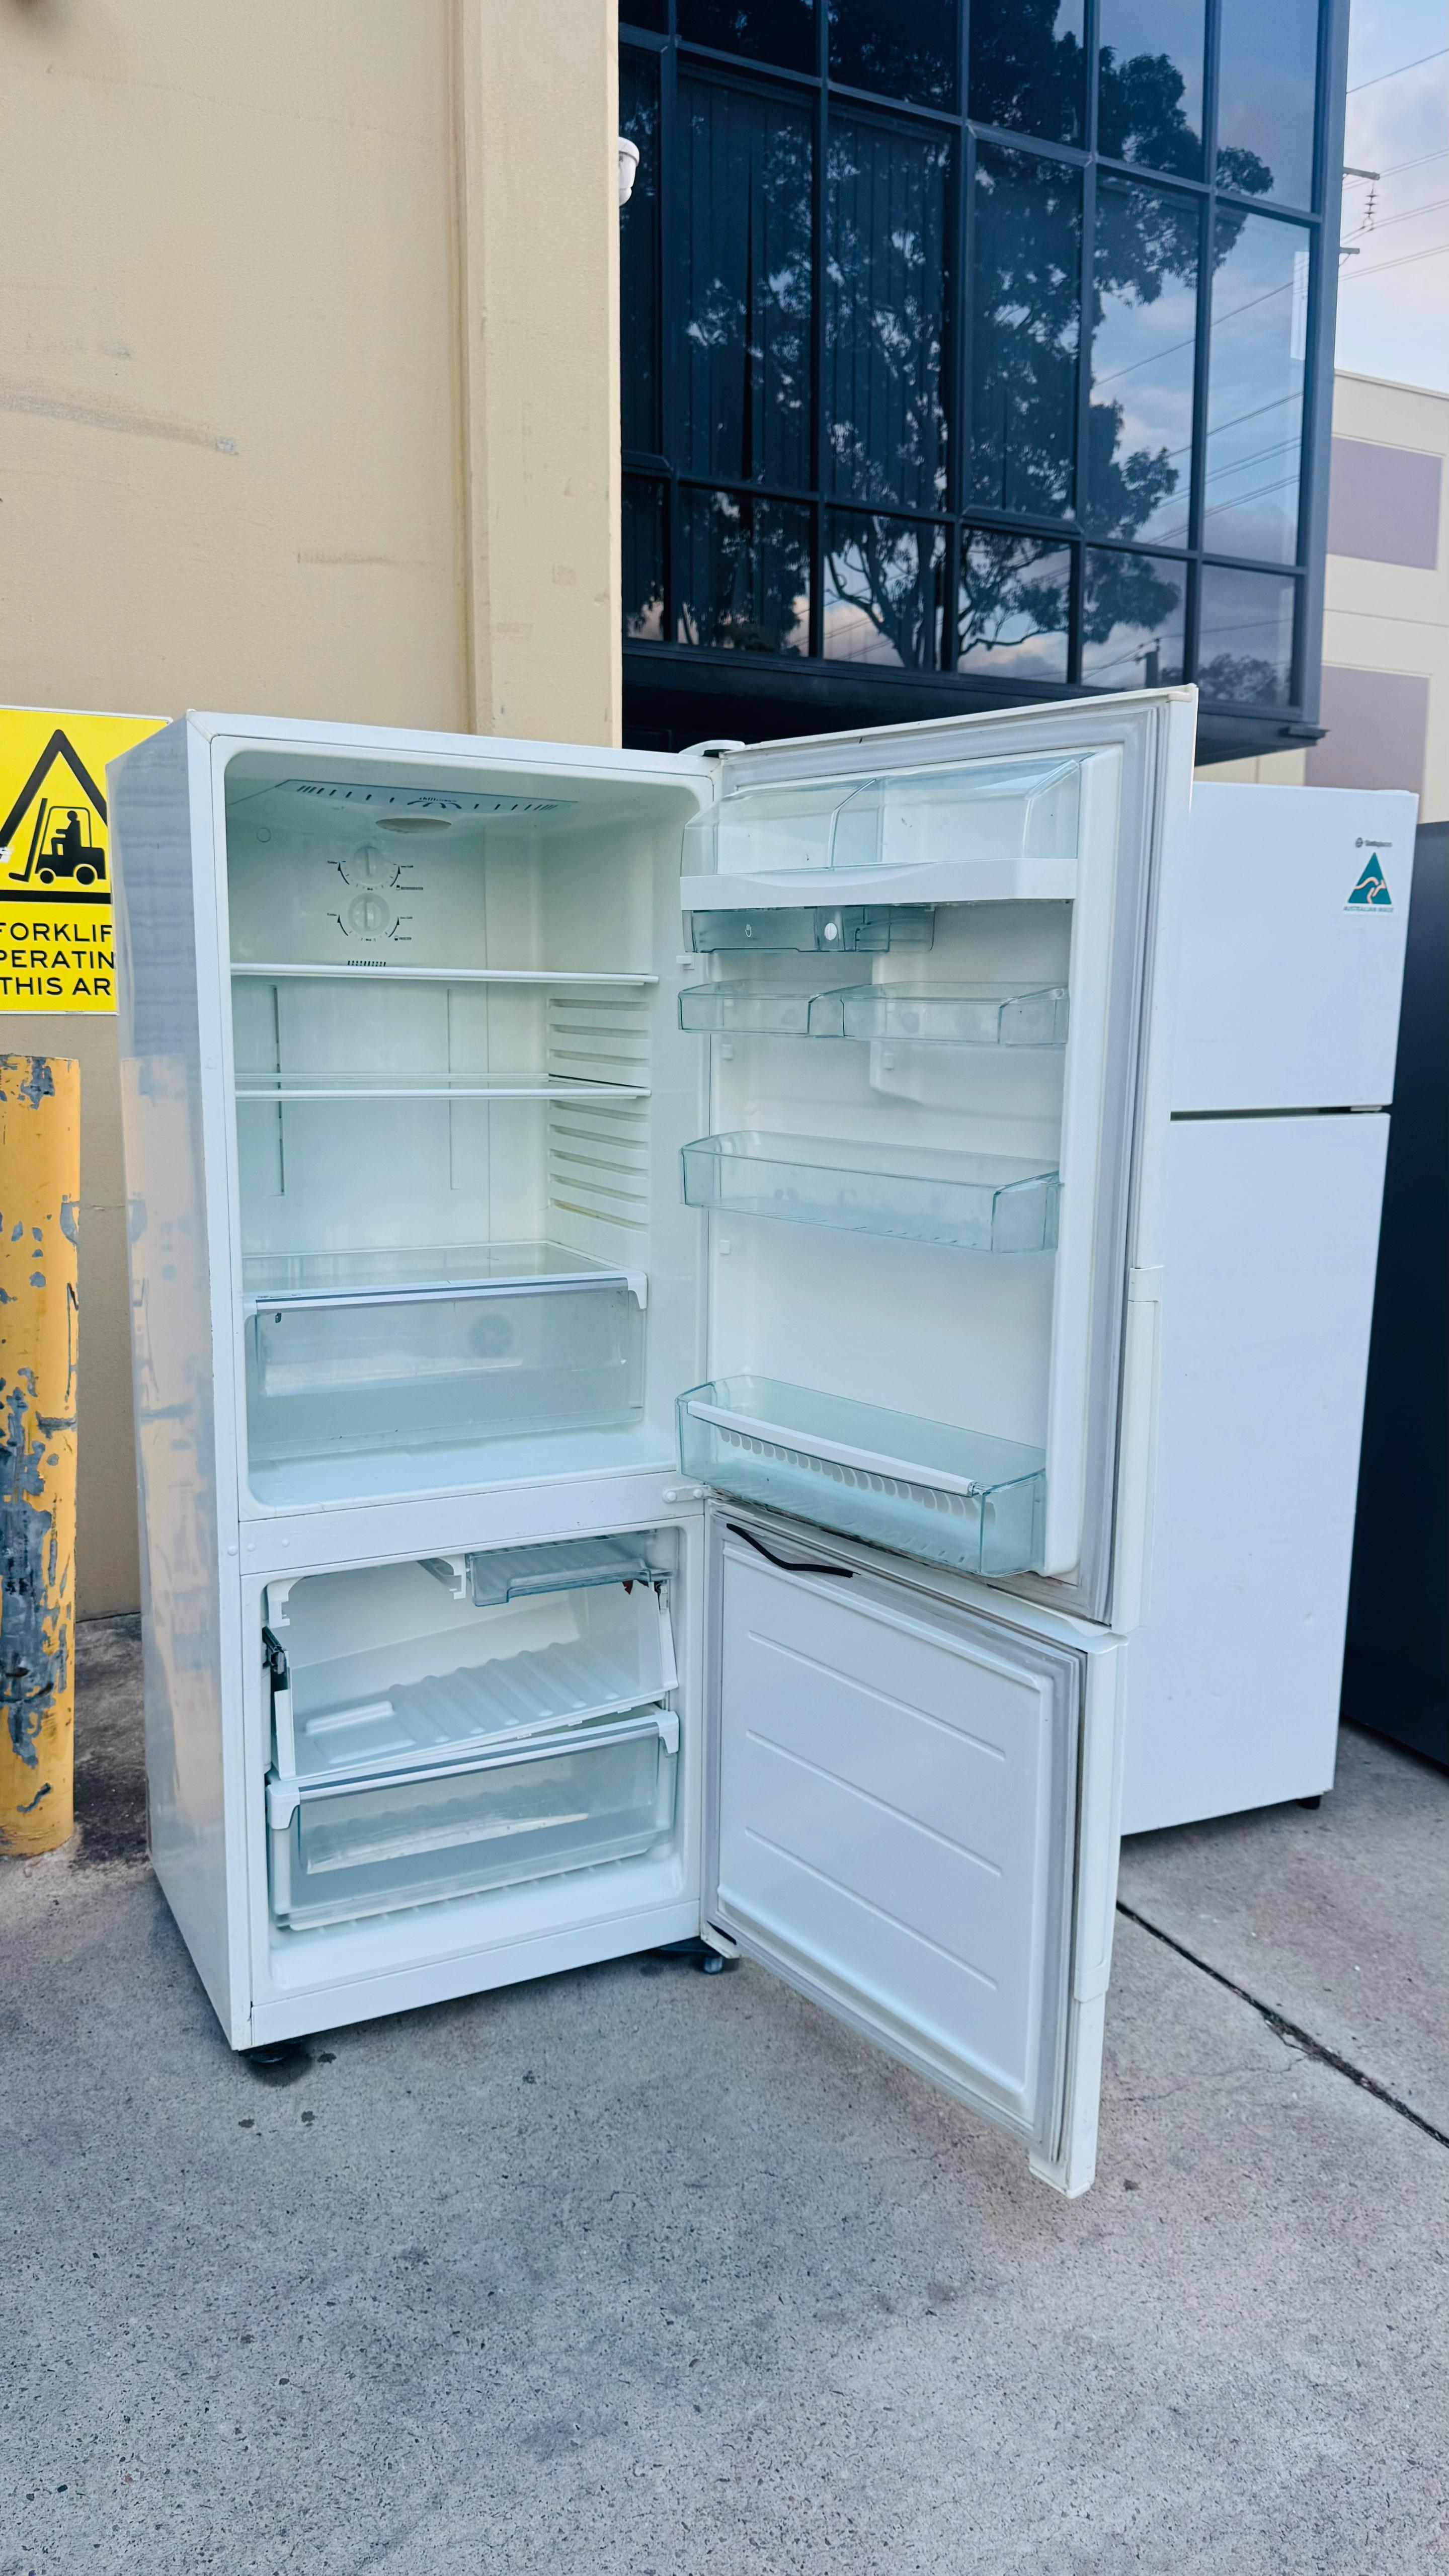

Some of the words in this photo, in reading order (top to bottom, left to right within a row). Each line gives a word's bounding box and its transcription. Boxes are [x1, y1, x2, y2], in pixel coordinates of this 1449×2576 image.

[0, 922, 112, 942] ORKLIF
[0, 950, 114, 969] ERATIN
[0, 977, 63, 996] THIS
[72, 978, 112, 996] AR
